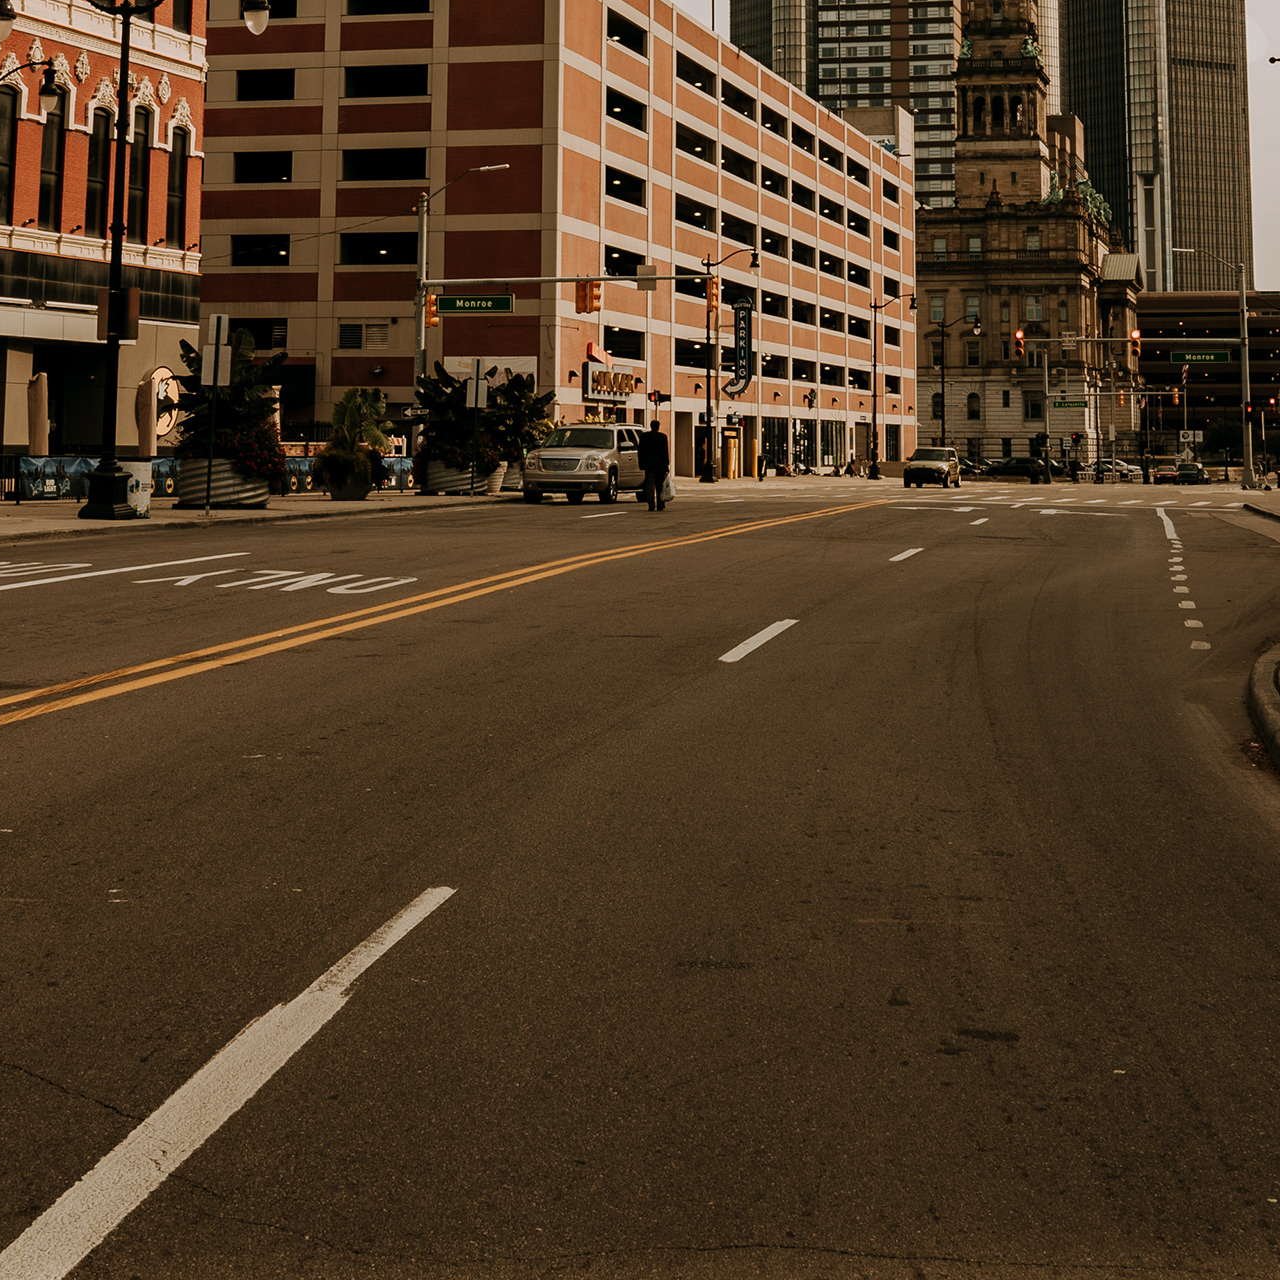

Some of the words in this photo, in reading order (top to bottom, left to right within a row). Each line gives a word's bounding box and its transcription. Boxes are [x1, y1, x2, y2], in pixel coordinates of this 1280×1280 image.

[456, 299, 493, 308] Monroe
[738, 310, 747, 377] PARKING
[131, 568, 419, 595] ONLY
